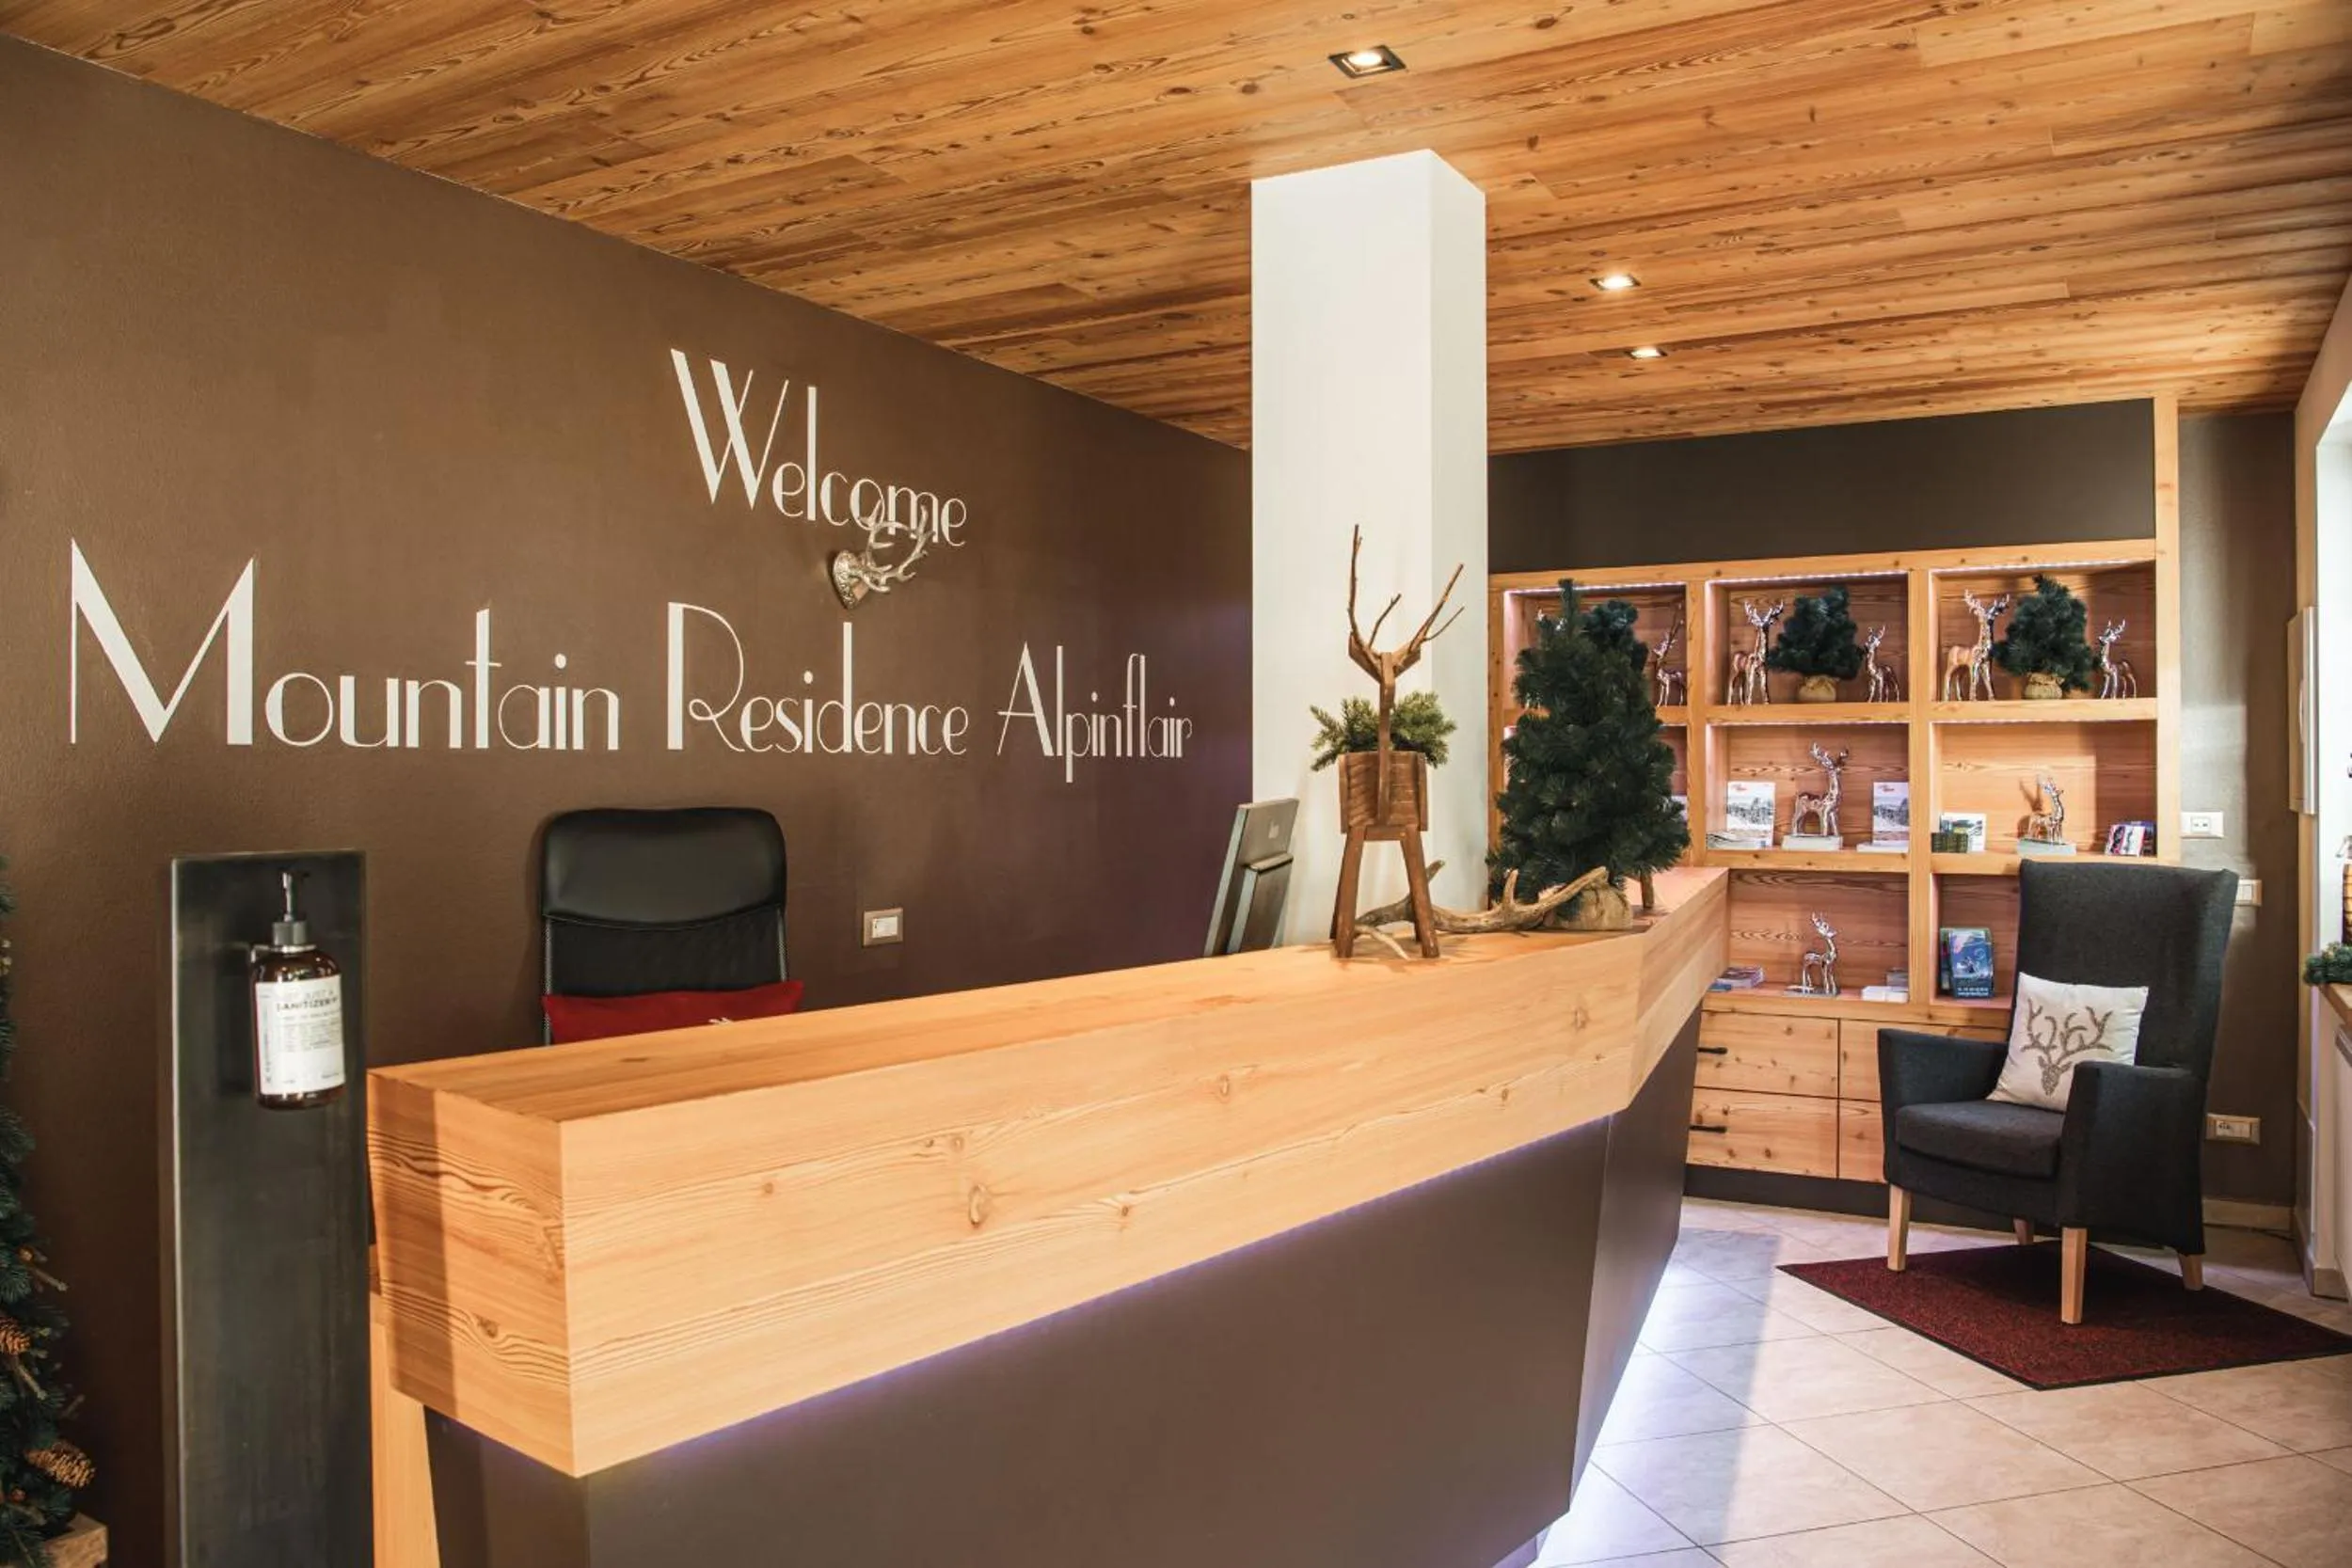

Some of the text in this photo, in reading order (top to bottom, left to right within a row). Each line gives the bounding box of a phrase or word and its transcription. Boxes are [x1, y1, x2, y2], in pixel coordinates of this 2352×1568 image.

[670, 348, 966, 546] Welcome
[70, 537, 1192, 784] Mountain Residence Alpinflair
